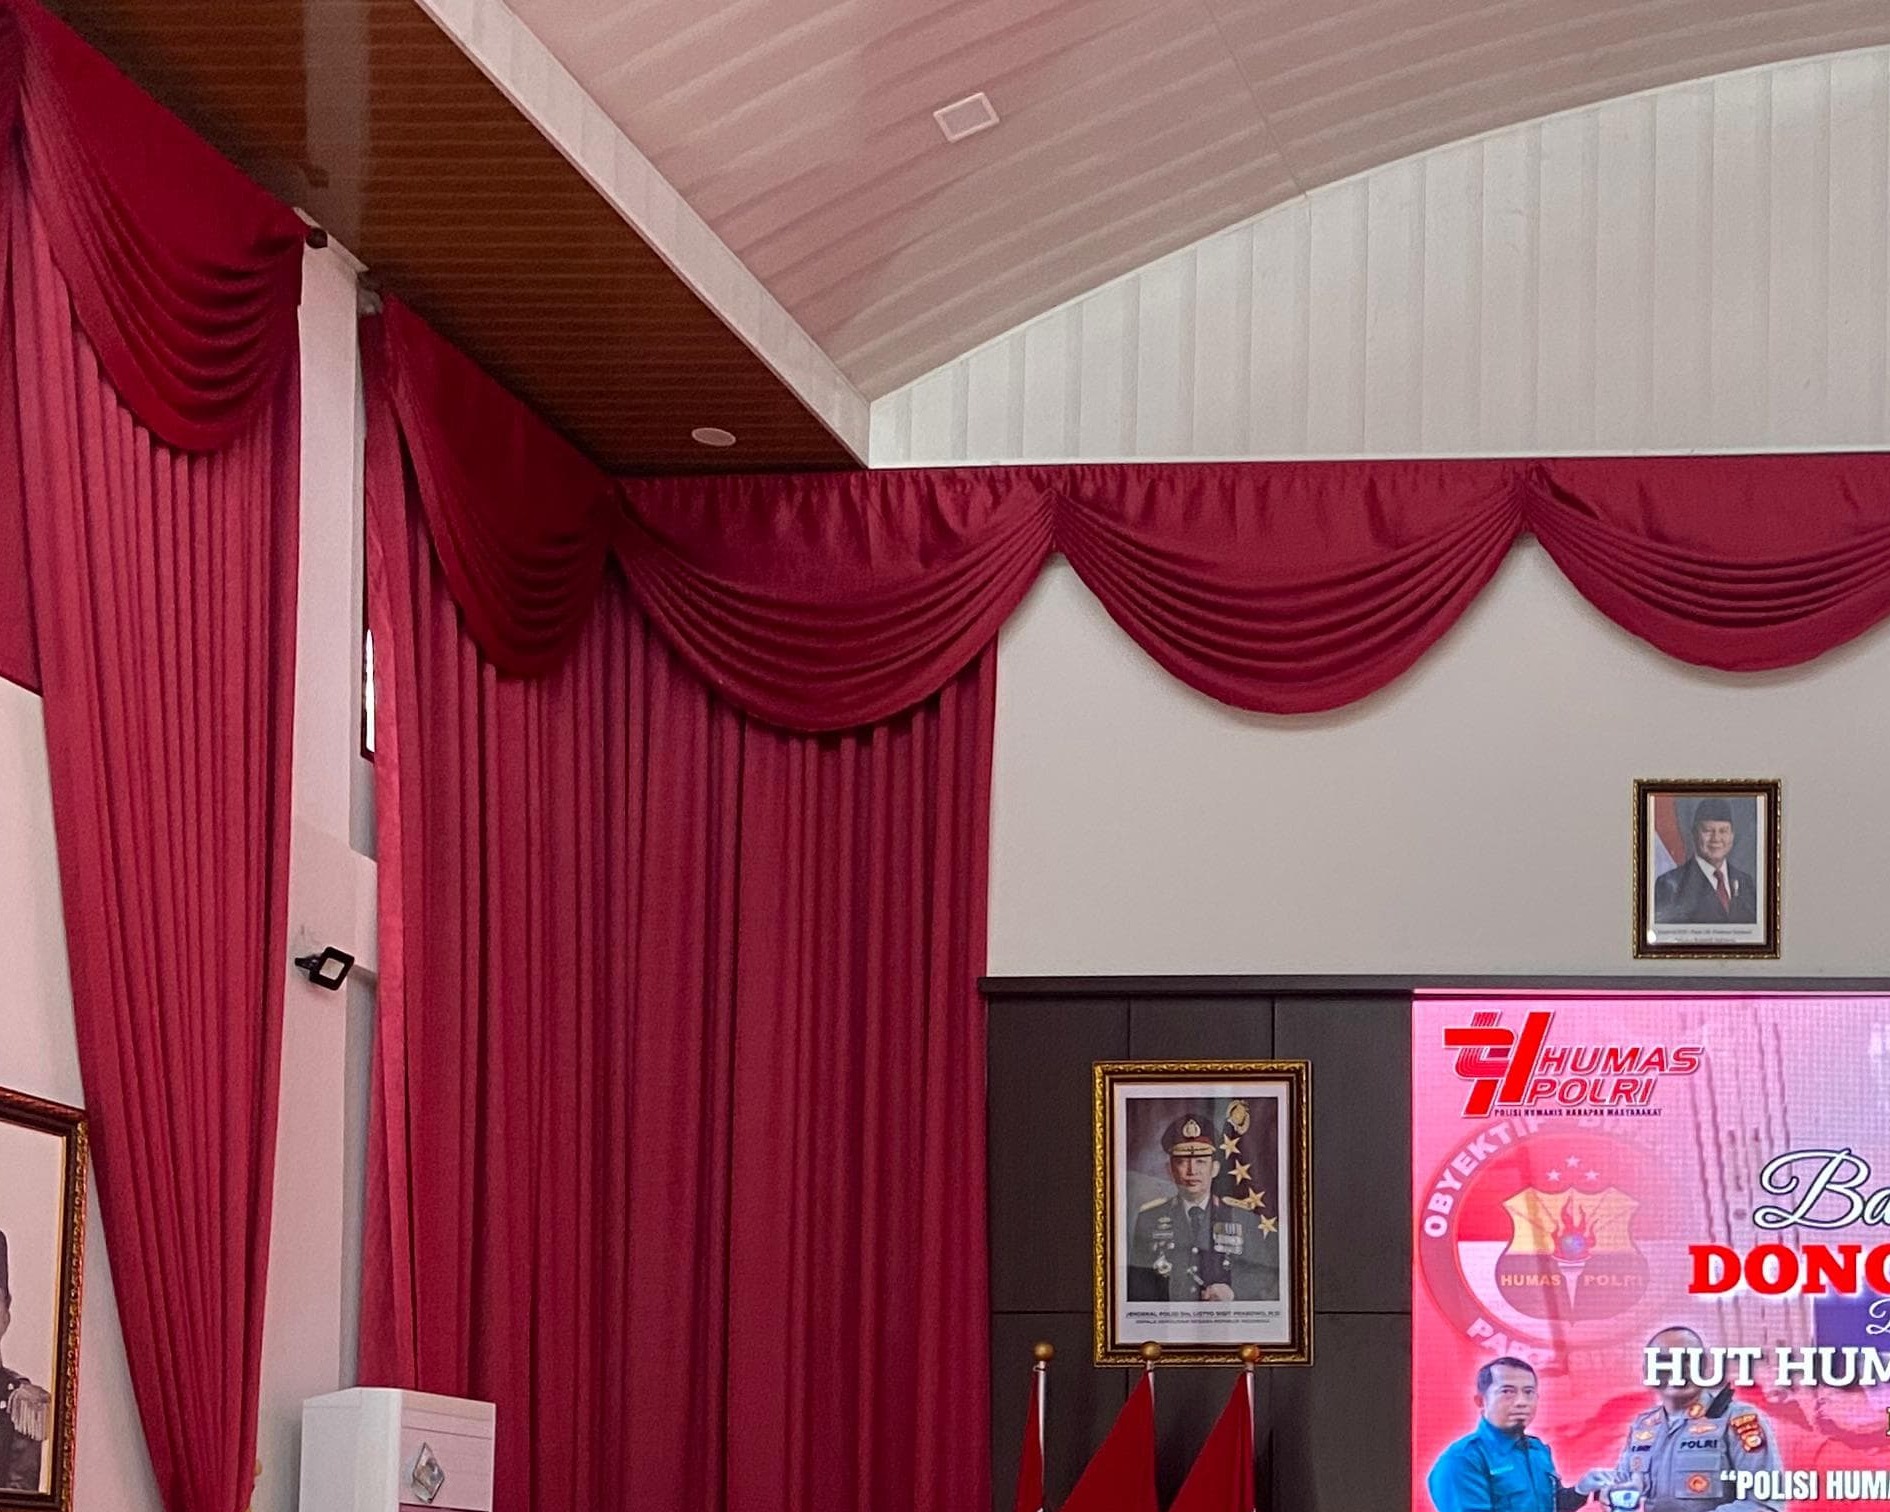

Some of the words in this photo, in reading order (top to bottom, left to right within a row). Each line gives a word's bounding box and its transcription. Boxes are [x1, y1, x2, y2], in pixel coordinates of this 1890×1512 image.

[1537, 1046, 1703, 1075] HUMAS
[1526, 1077, 1657, 1106] POLRI
[1494, 1108, 1522, 1117] POLISI
[1524, 1108, 1563, 1117] HUMANIS
[1566, 1108, 1604, 1117] HARAPAN
[1607, 1108, 1662, 1117] MASYARAKAT
[1501, 1274, 1561, 1286] HUMAS
[1643, 1346, 1762, 1387] HUT
[1720, 1470, 1818, 1500] “POLISI
